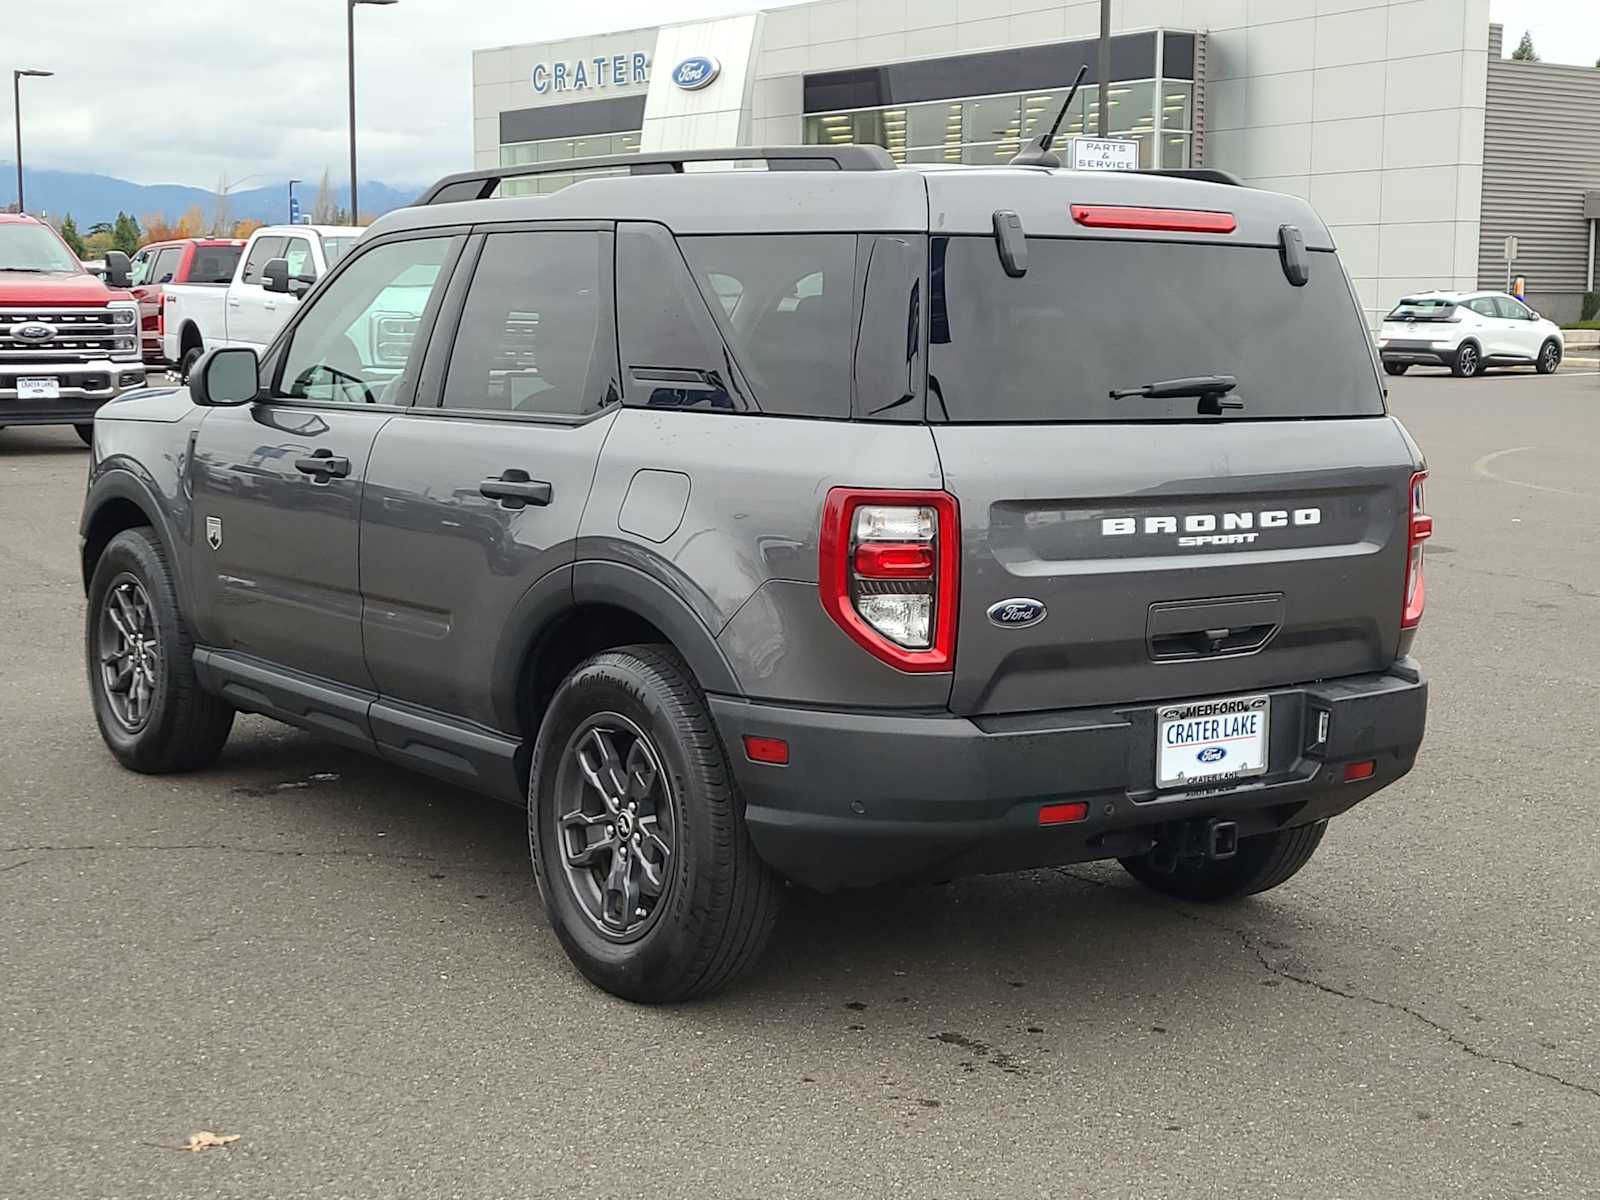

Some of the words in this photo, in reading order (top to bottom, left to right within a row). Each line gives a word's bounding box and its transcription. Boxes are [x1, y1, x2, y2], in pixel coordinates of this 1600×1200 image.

[533, 52, 648, 93] CRATER
[678, 61, 706, 83] Ford
[1086, 143, 1127, 152] PARTS
[1078, 160, 1134, 169] SERVICE
[1102, 508, 1321, 536] BRONCO
[1178, 532, 1259, 547] SPORT
[1002, 603, 1035, 621] Ford
[1185, 701, 1245, 718] MEDFORD
[1167, 719, 1220, 745] CRATER
[1223, 714, 1257, 737] LAKE
[1201, 749, 1223, 761] Ford
